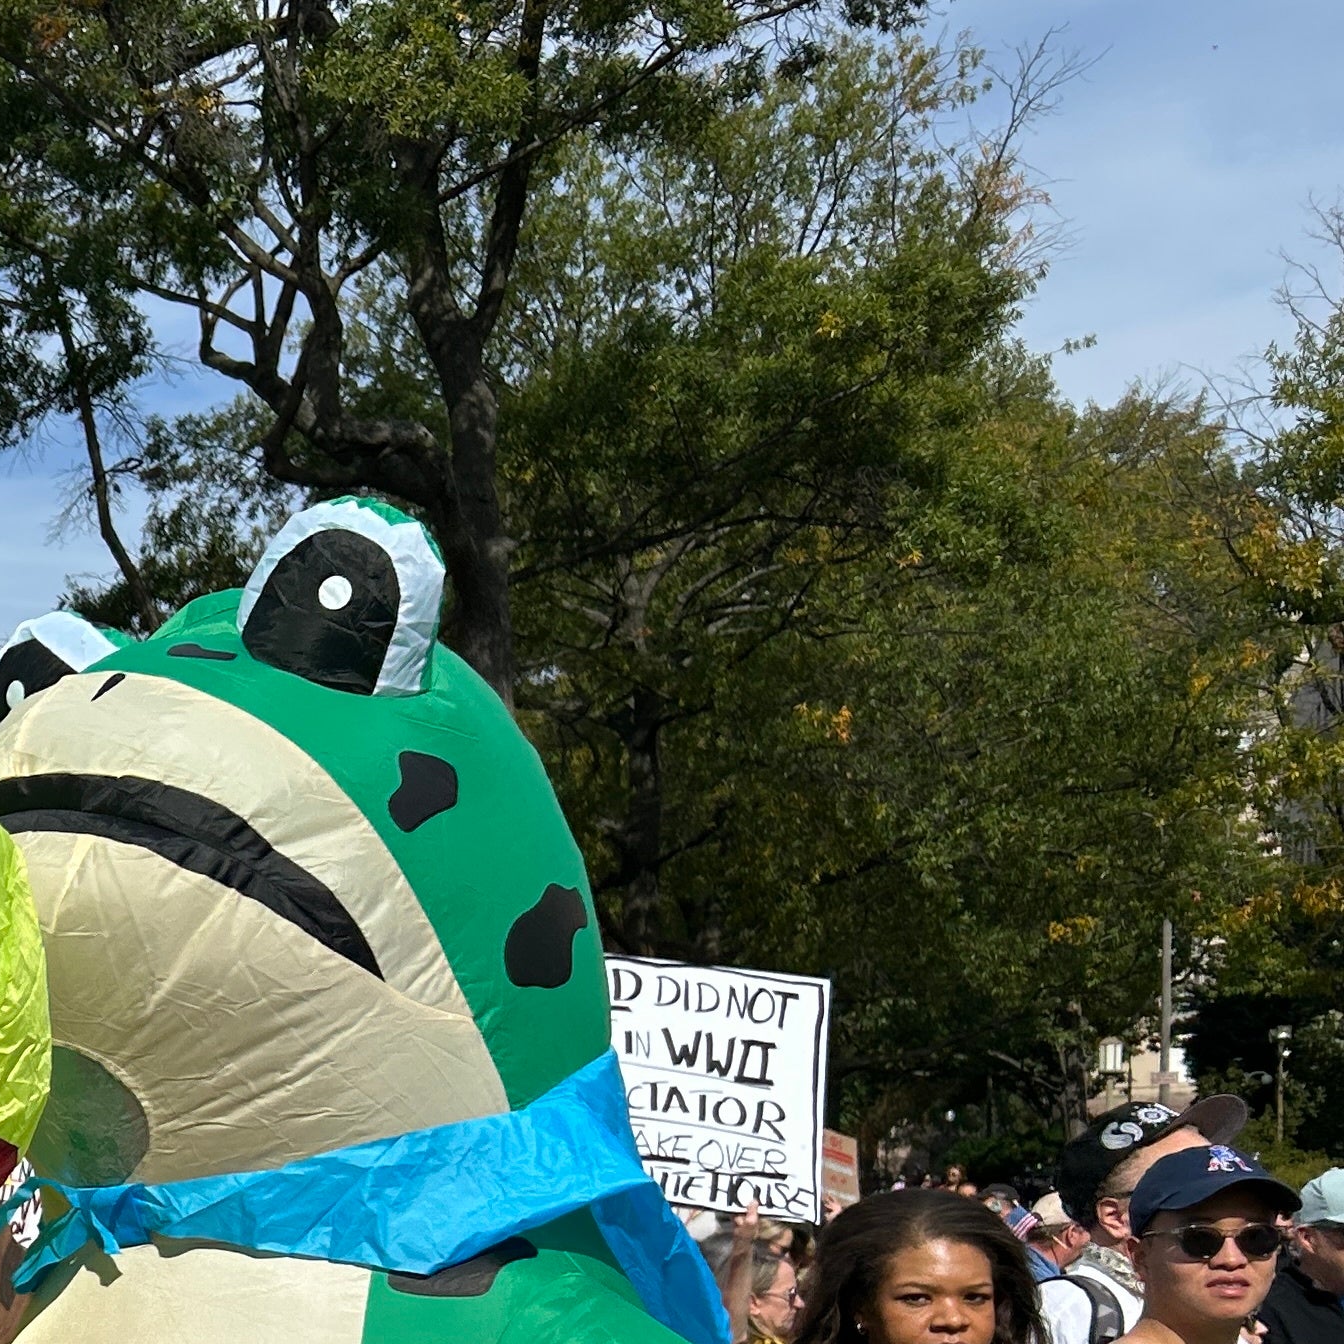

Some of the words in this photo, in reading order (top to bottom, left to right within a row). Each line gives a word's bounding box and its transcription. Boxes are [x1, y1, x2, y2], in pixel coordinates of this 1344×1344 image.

[654, 975, 721, 1013] DID
[726, 983, 800, 1030] NOT
[624, 1030, 651, 1060] IN
[661, 1027, 778, 1086] WWII
[696, 1138, 787, 1176] OVER
[709, 1171, 816, 1217] HOUSE
